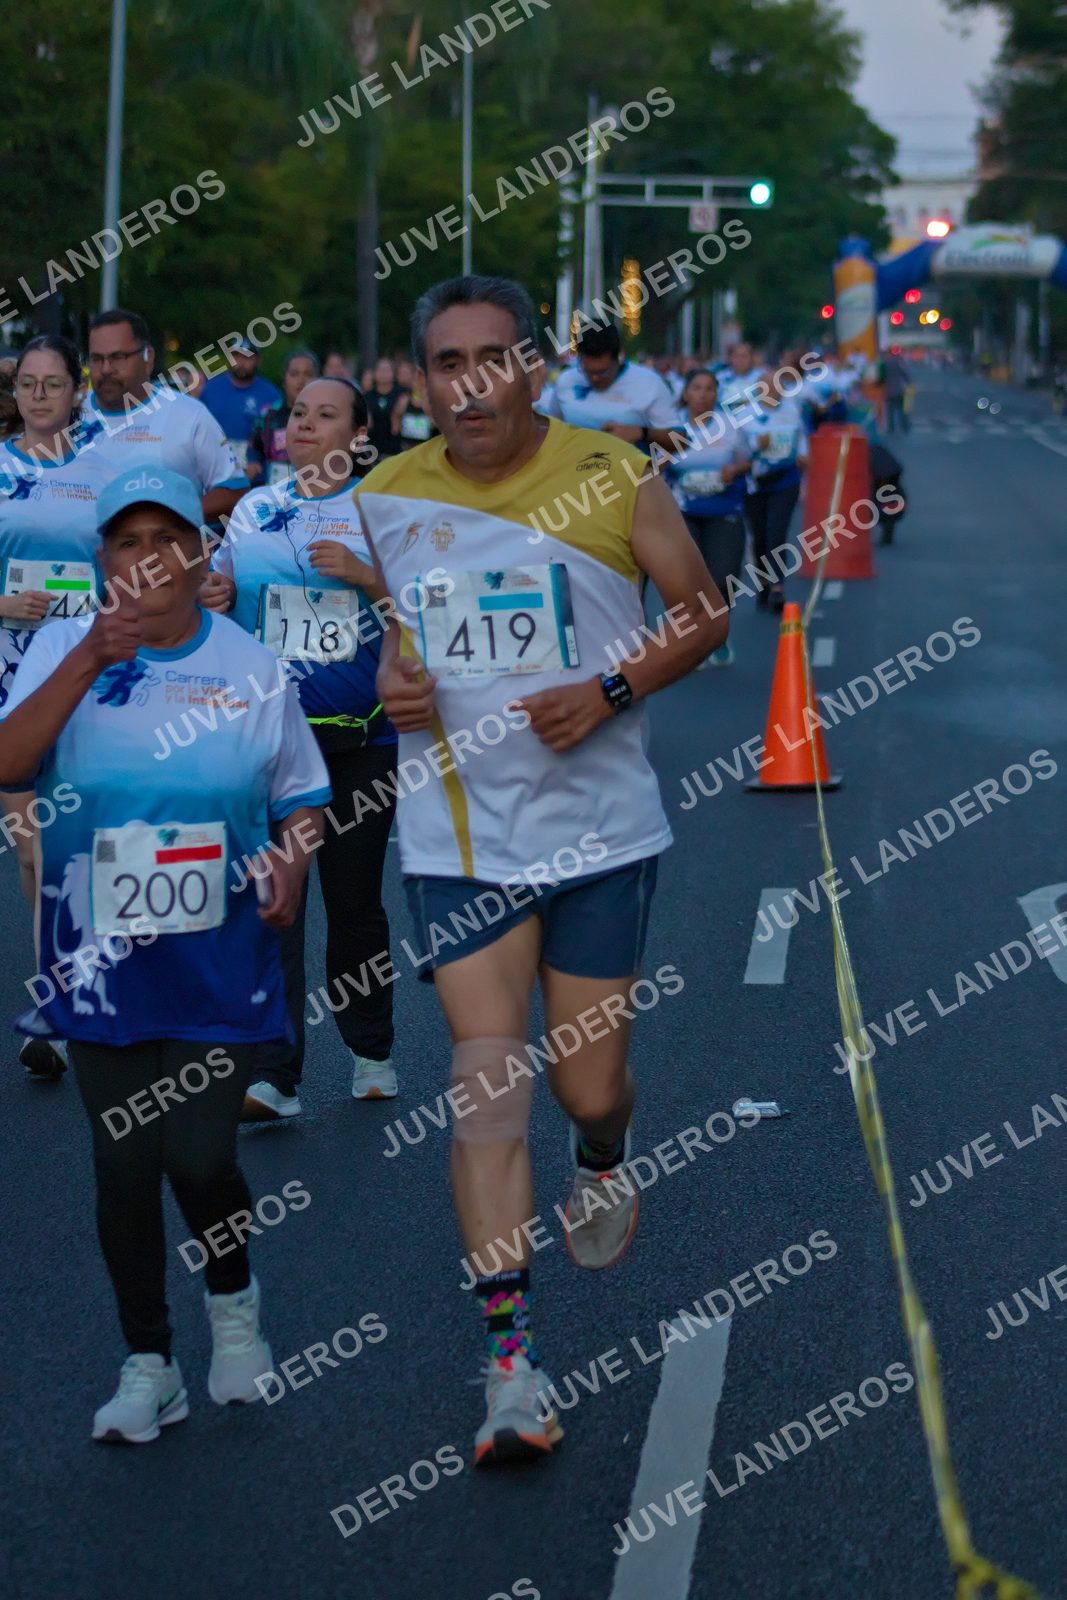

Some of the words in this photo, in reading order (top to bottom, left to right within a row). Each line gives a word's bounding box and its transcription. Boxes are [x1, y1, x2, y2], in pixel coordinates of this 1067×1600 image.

[124, 472, 164, 492] alo
[309, 514, 350, 522] Carrera
[281, 618, 339, 652] 118
[446, 612, 536, 662] 419
[165, 670, 226, 687] Carrera
[113, 870, 208, 919] 200
